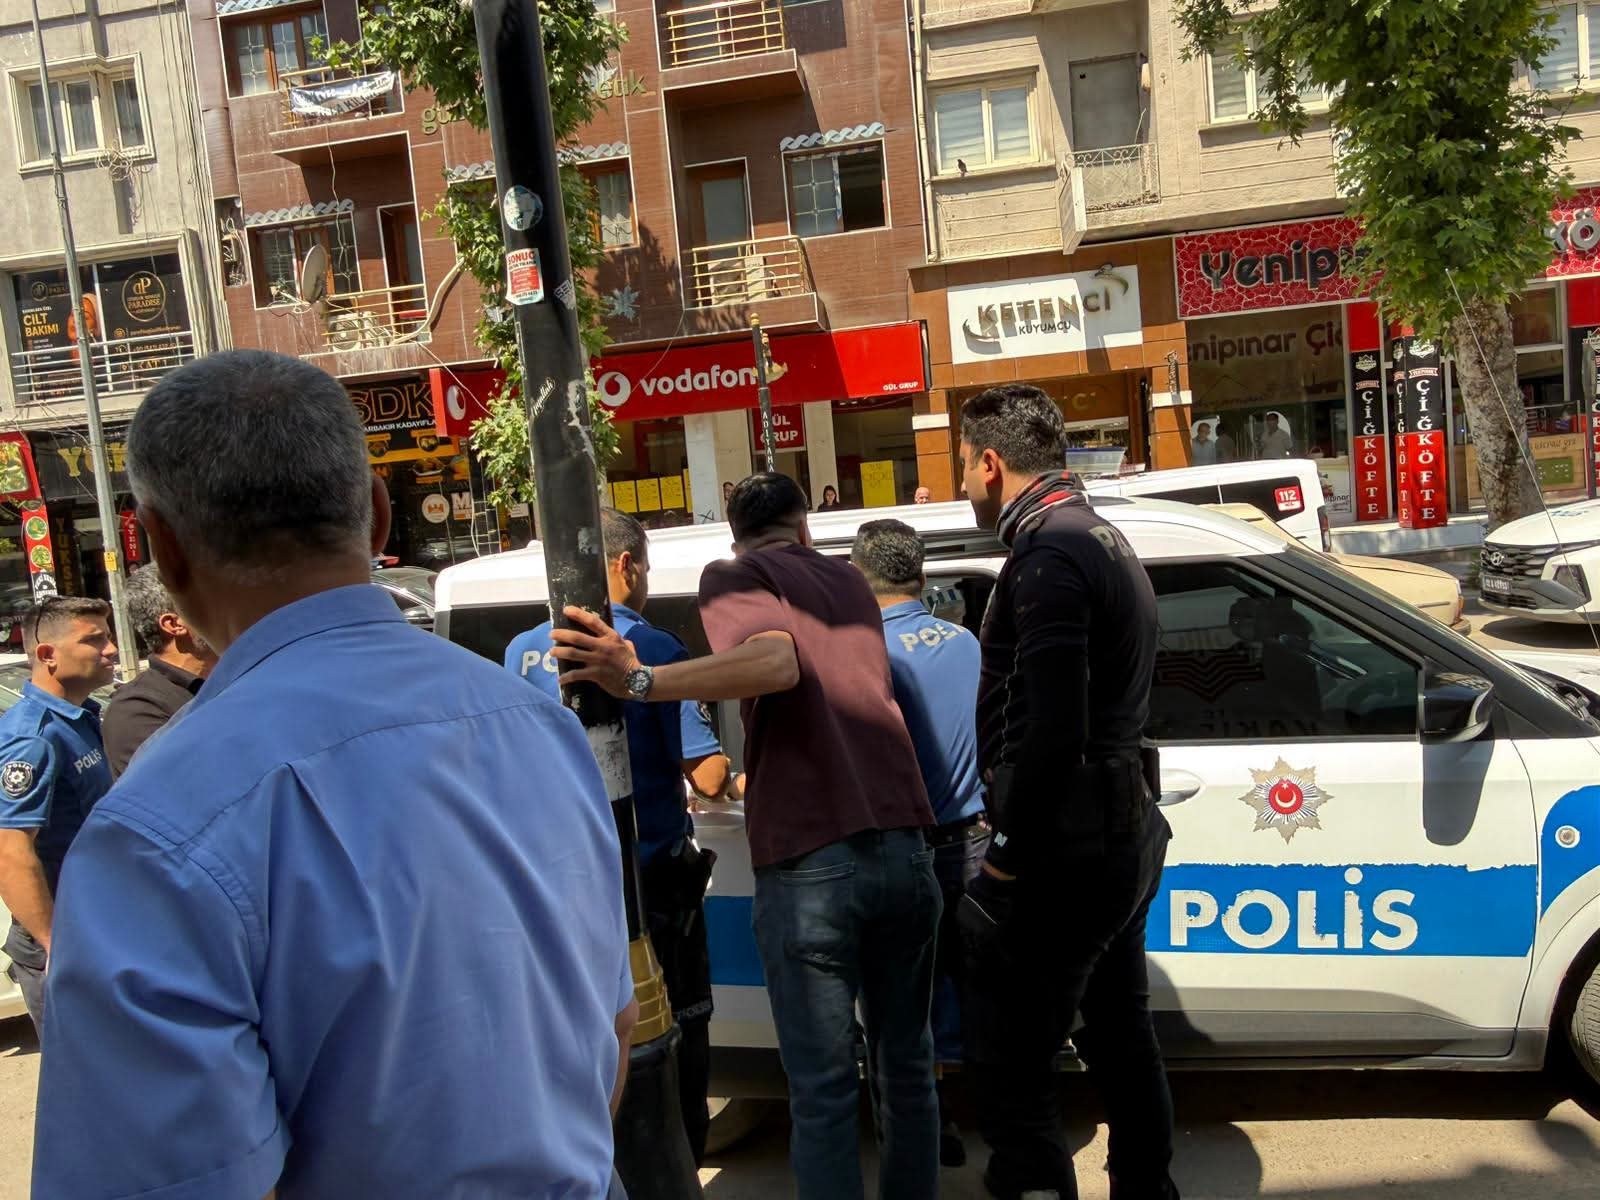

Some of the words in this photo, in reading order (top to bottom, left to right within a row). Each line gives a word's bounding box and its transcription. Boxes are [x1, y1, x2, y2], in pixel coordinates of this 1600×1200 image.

[1019, 320, 1071, 335] KUYUMCU
[640, 363, 761, 396] vodafon
[364, 424, 395, 433] ARBAKIR
[396, 420, 437, 430] KADAYIFLA
[771, 413, 791, 426] ÜL
[763, 411, 774, 472] ADIYAMA
[1418, 433, 1436, 519] KÖFTE
[1279, 489, 1297, 502] 112
[521, 651, 558, 676] PO
[73, 748, 102, 772] POLİS
[1169, 867, 1419, 951] POLİS
